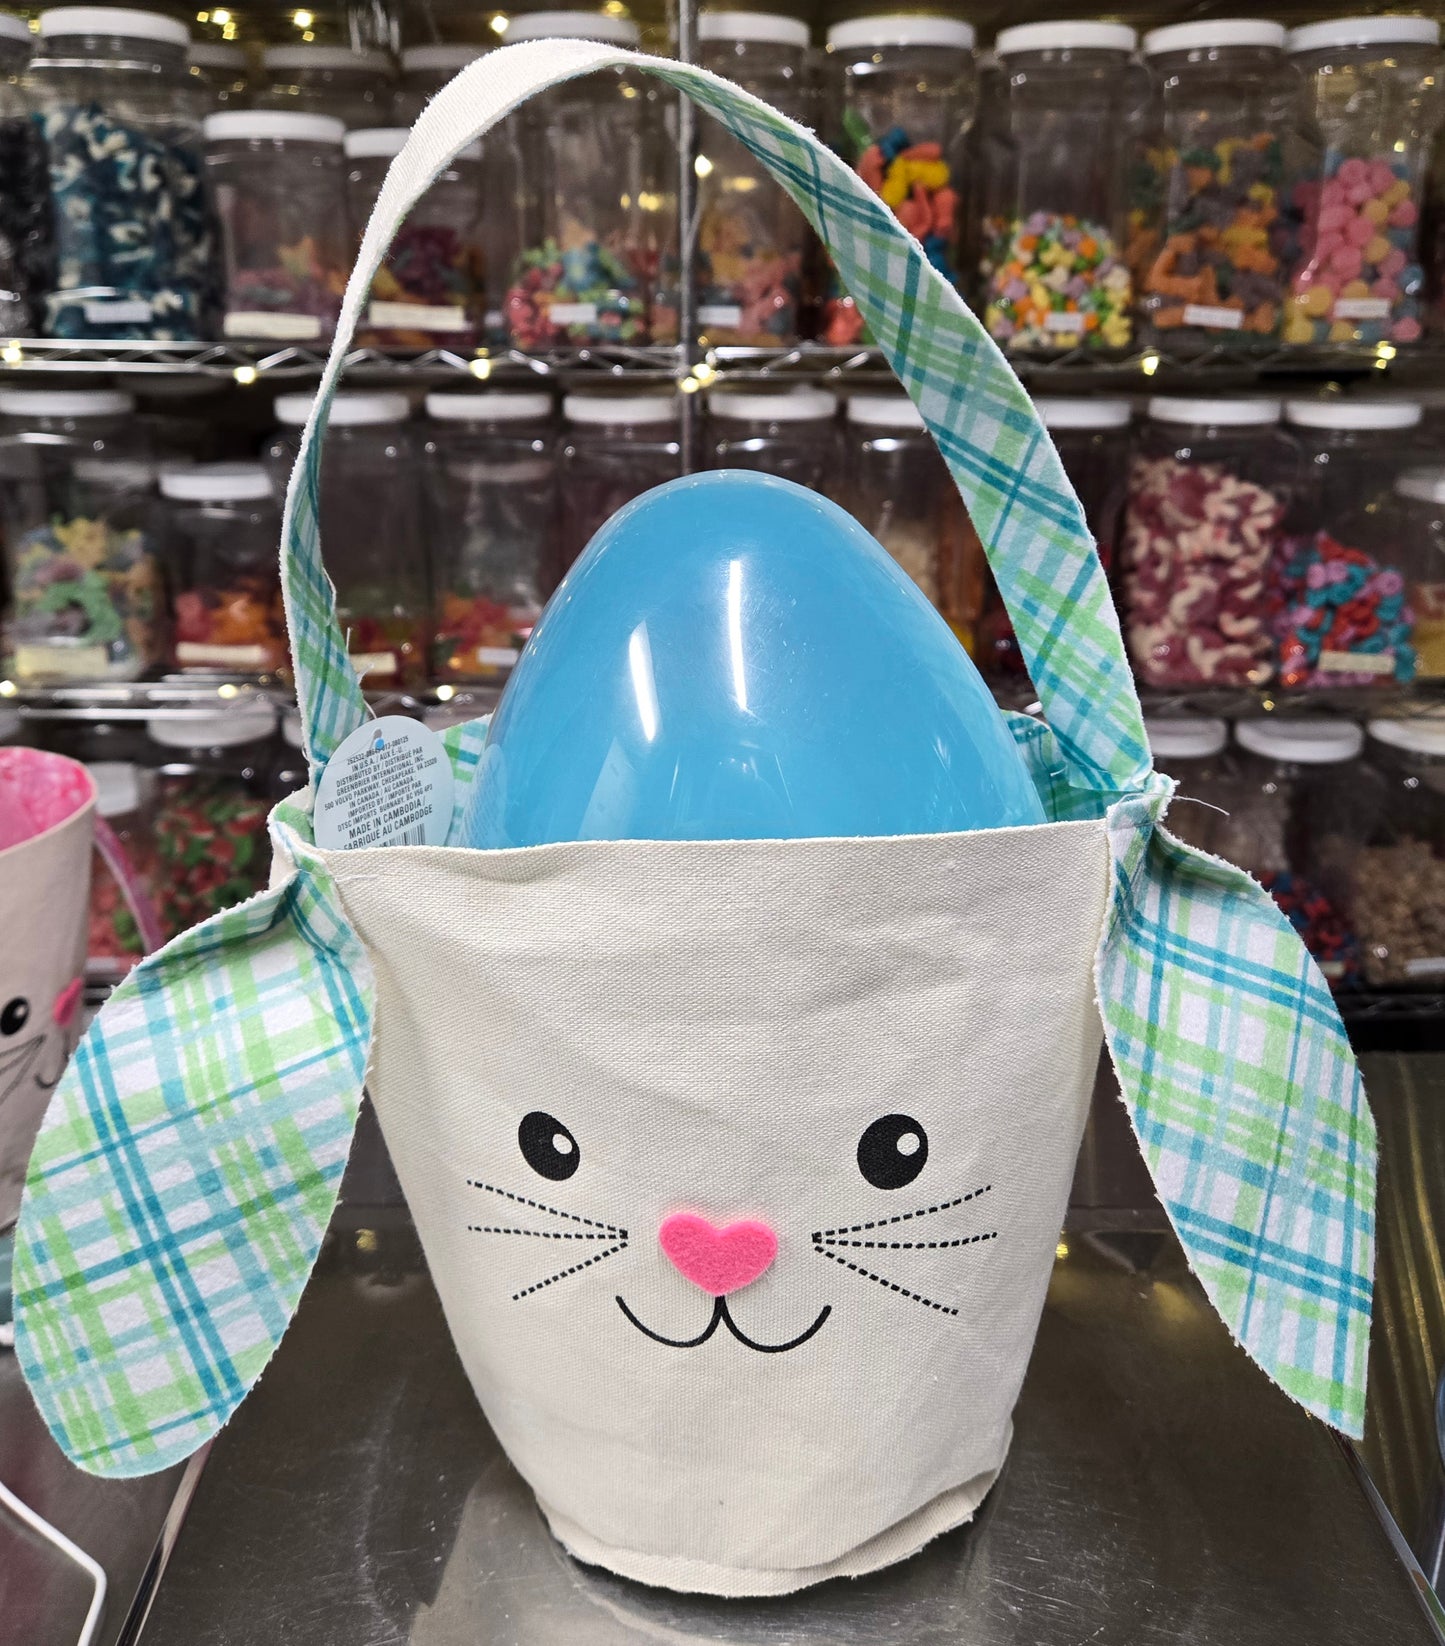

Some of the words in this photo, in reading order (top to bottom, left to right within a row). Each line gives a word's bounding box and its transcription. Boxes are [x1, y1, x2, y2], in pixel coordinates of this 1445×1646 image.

[336, 767, 372, 788] DISTRIBUTED
[373, 763, 381, 773] BY
[413, 746, 423, 756] PAR
[352, 763, 358, 772] IN
[380, 750, 391, 760] AUX
[324, 801, 334, 811] 500
[335, 793, 352, 806] VOLVO
[416, 763, 423, 771] VA
[424, 757, 437, 768] 23320
[336, 777, 370, 797] GREENBRIER
[348, 800, 376, 818] IMPORTED
[376, 797, 384, 806] BY
[411, 780, 422, 790] PAR
[349, 800, 356, 809] IN
[357, 790, 380, 805] CANADA
[384, 784, 391, 793] AU
[392, 775, 414, 790] CANADA
[337, 820, 352, 832] DTSC
[406, 791, 413, 801] BC
[414, 787, 424, 797] V5G
[349, 821, 371, 839] MADE
[373, 815, 382, 828] IN
[383, 798, 422, 823] CAMBODIA
[382, 824, 393, 836] AU
[394, 804, 433, 830] CAMBODGE
